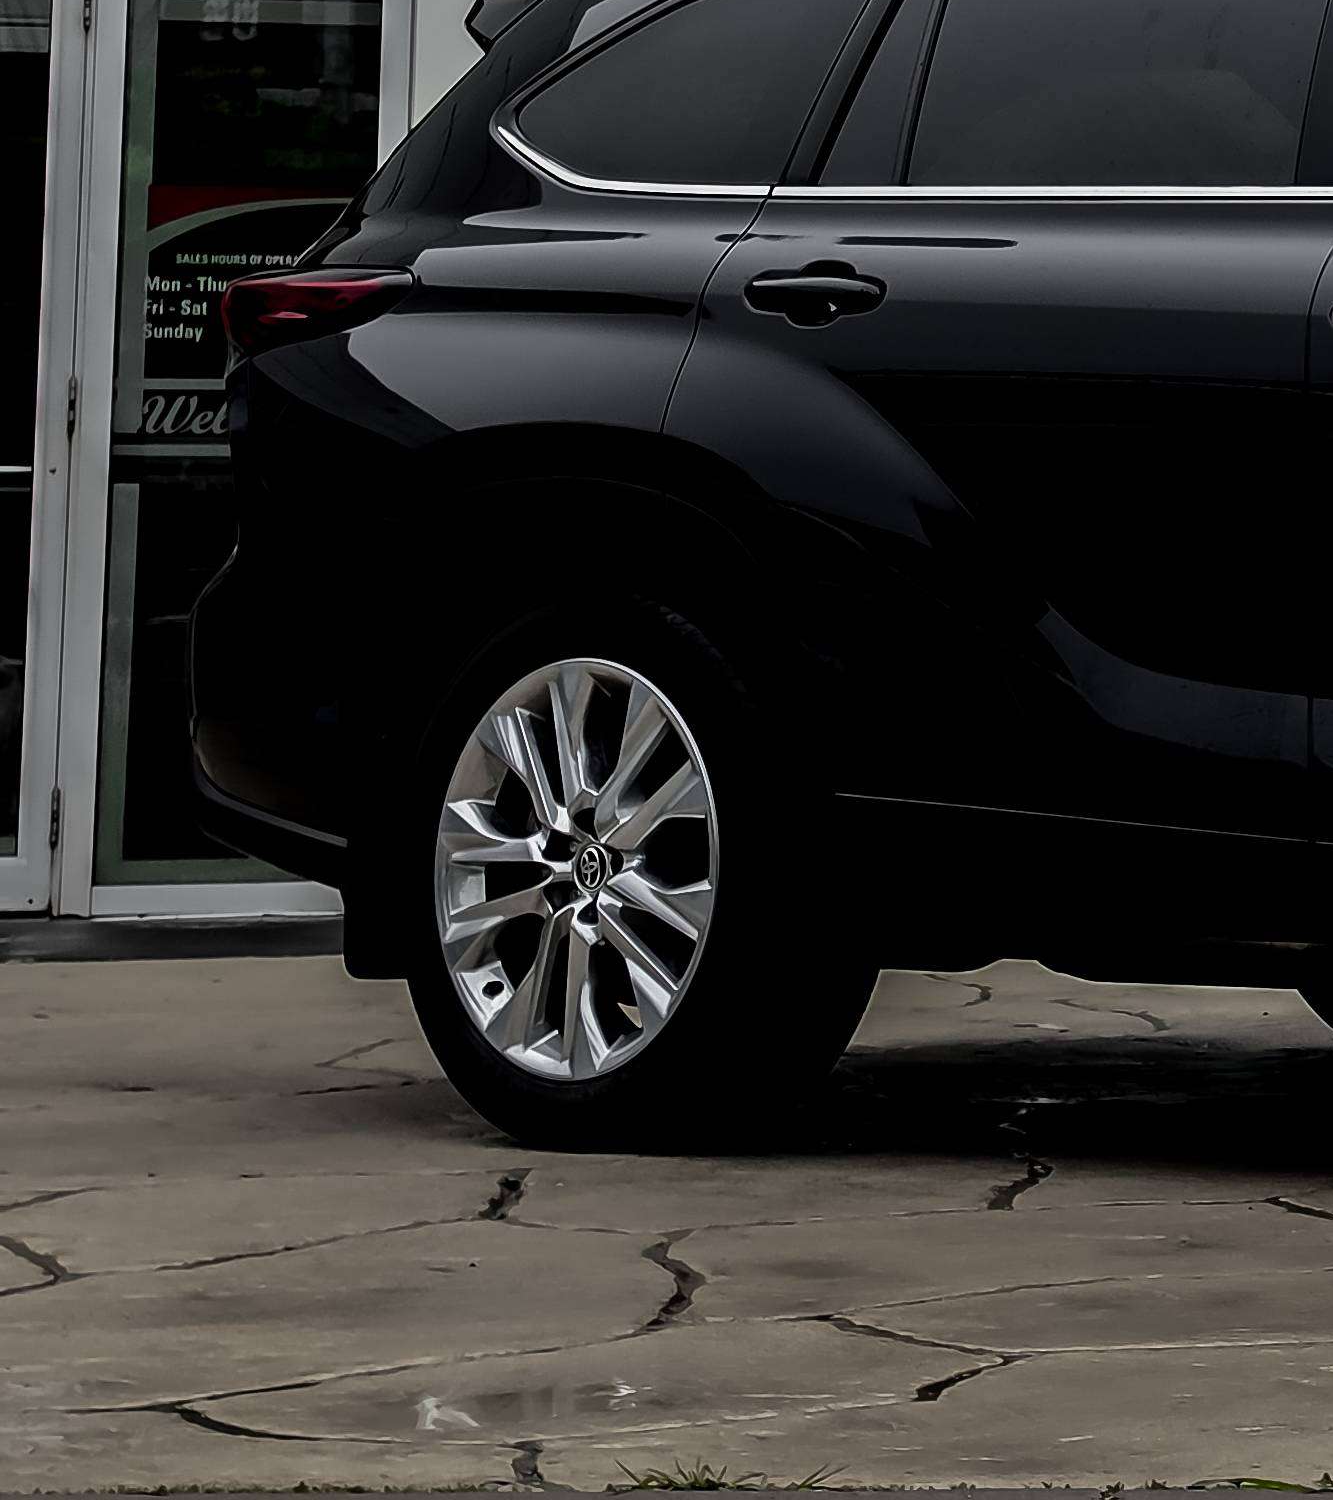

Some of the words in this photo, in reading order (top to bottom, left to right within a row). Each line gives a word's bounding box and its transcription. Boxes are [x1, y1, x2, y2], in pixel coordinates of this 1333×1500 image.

[210, 252, 247, 265] HOURS
[144, 275, 181, 292] Mon
[143, 298, 164, 316] Fri
[180, 299, 208, 316] Sat
[143, 322, 204, 343] Sunday
